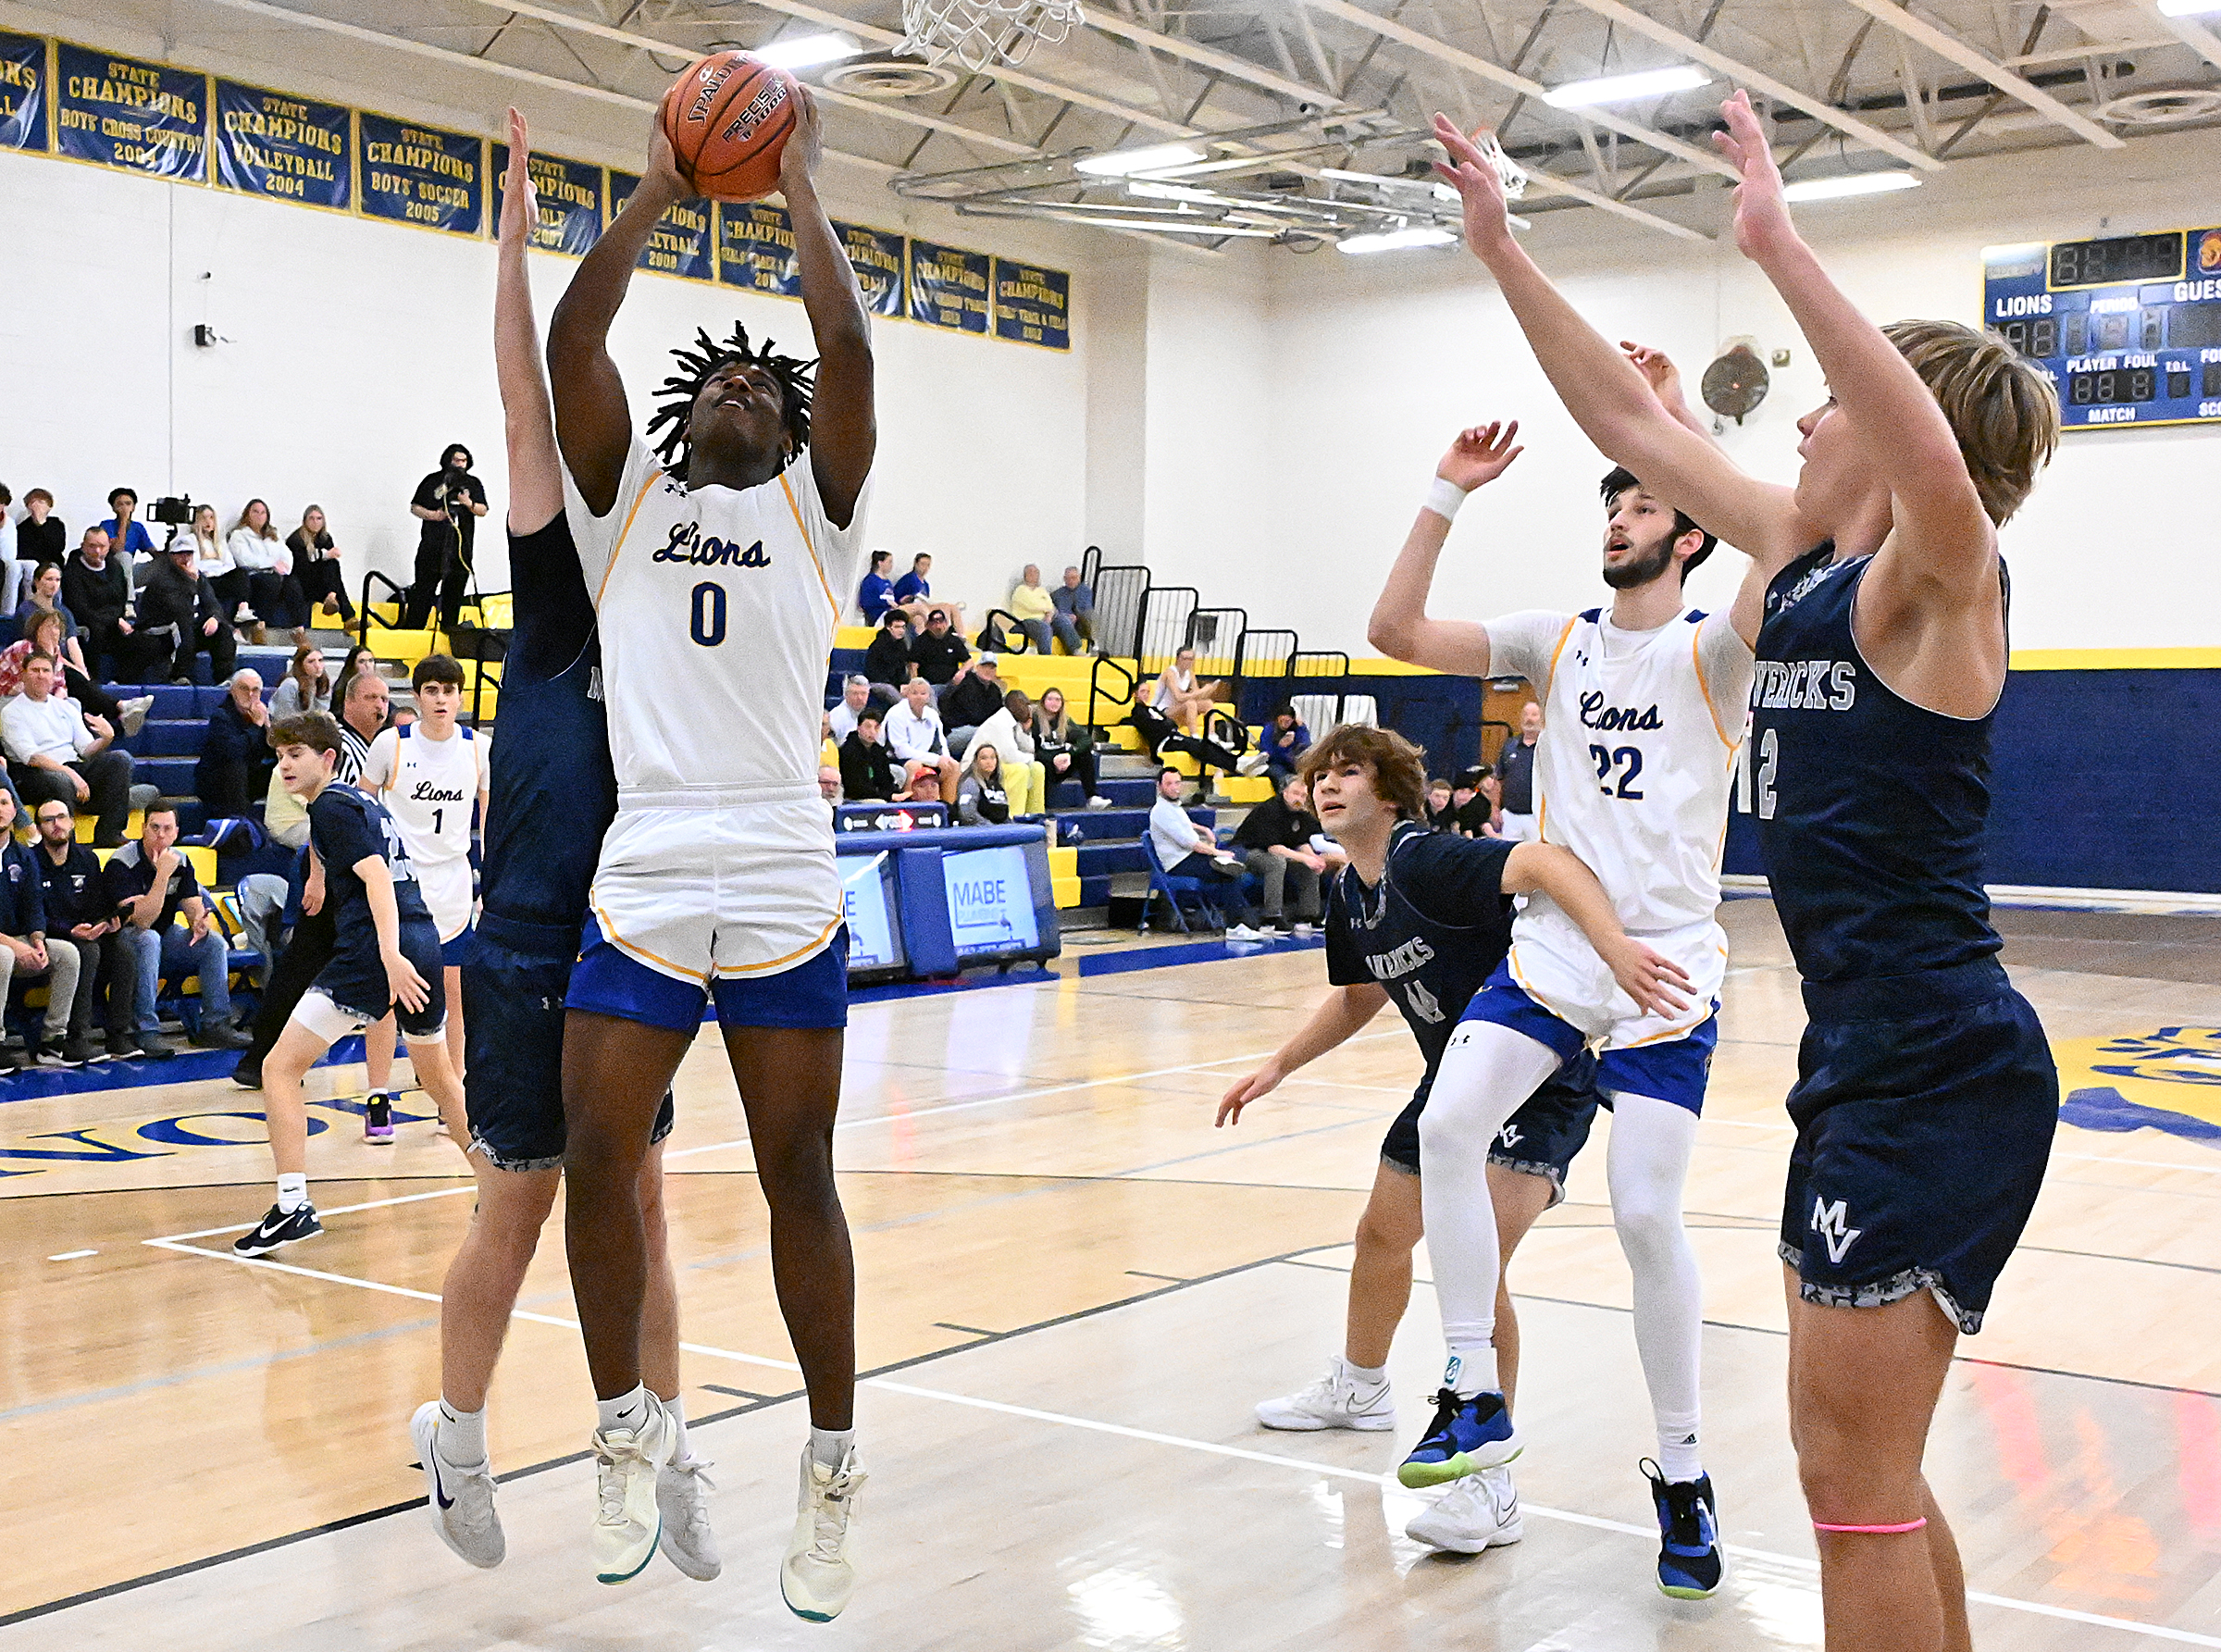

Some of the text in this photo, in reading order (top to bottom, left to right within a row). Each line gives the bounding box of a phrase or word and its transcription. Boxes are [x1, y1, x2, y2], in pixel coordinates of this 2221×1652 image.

[108, 62, 159, 88] STATE
[68, 76, 197, 124] CHAMPIONS
[263, 96, 308, 121] STATE
[224, 110, 342, 155] CHAMPIONS
[401, 129, 444, 151] STATE
[232, 143, 334, 181] VOLLEYBALL
[367, 142, 474, 183] CHAMPIONS
[266, 173, 304, 196] 2004
[418, 181, 469, 209] SOCCER
[406, 201, 440, 222] 2005
[1996, 294, 2053, 317] LIONS
[2091, 297, 2140, 315] PERIOD
[2066, 354, 2158, 373] PLAYER FOUL
[2089, 407, 2136, 423] MATCH
[652, 521, 772, 568] Lions
[690, 581, 726, 646] 0
[1589, 743, 1644, 801] 22
[411, 781, 465, 801] Lions
[432, 808, 443, 835] 1
[953, 879, 1006, 906] MABE
[1811, 1196, 1863, 1264] MV
